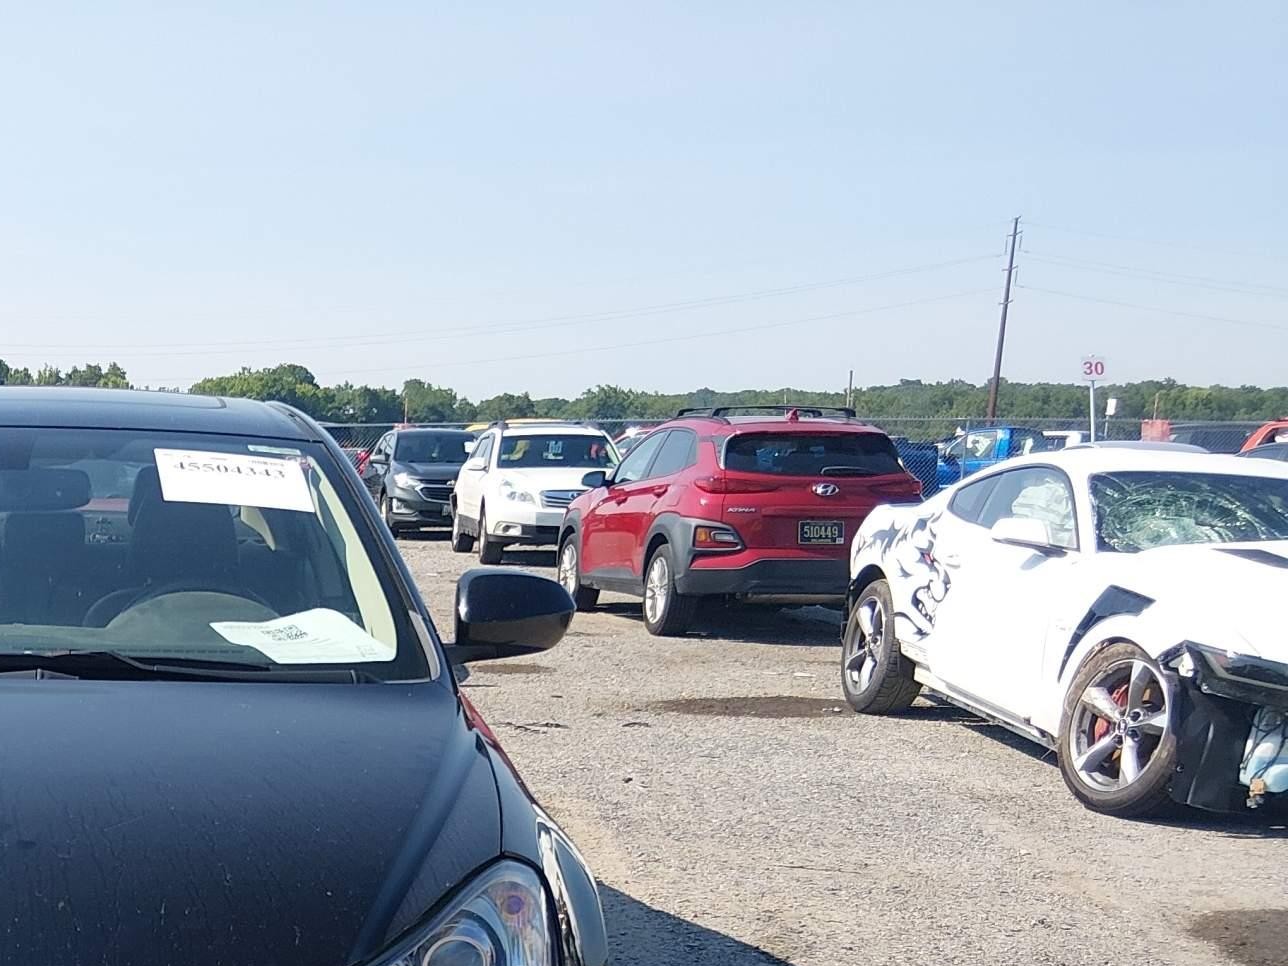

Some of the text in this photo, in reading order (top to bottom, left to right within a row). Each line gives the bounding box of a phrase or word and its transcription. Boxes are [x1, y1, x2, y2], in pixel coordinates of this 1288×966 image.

[1083, 361, 1105, 376] 30
[173, 461, 286, 479] 45504343
[803, 525, 839, 538] 510449
